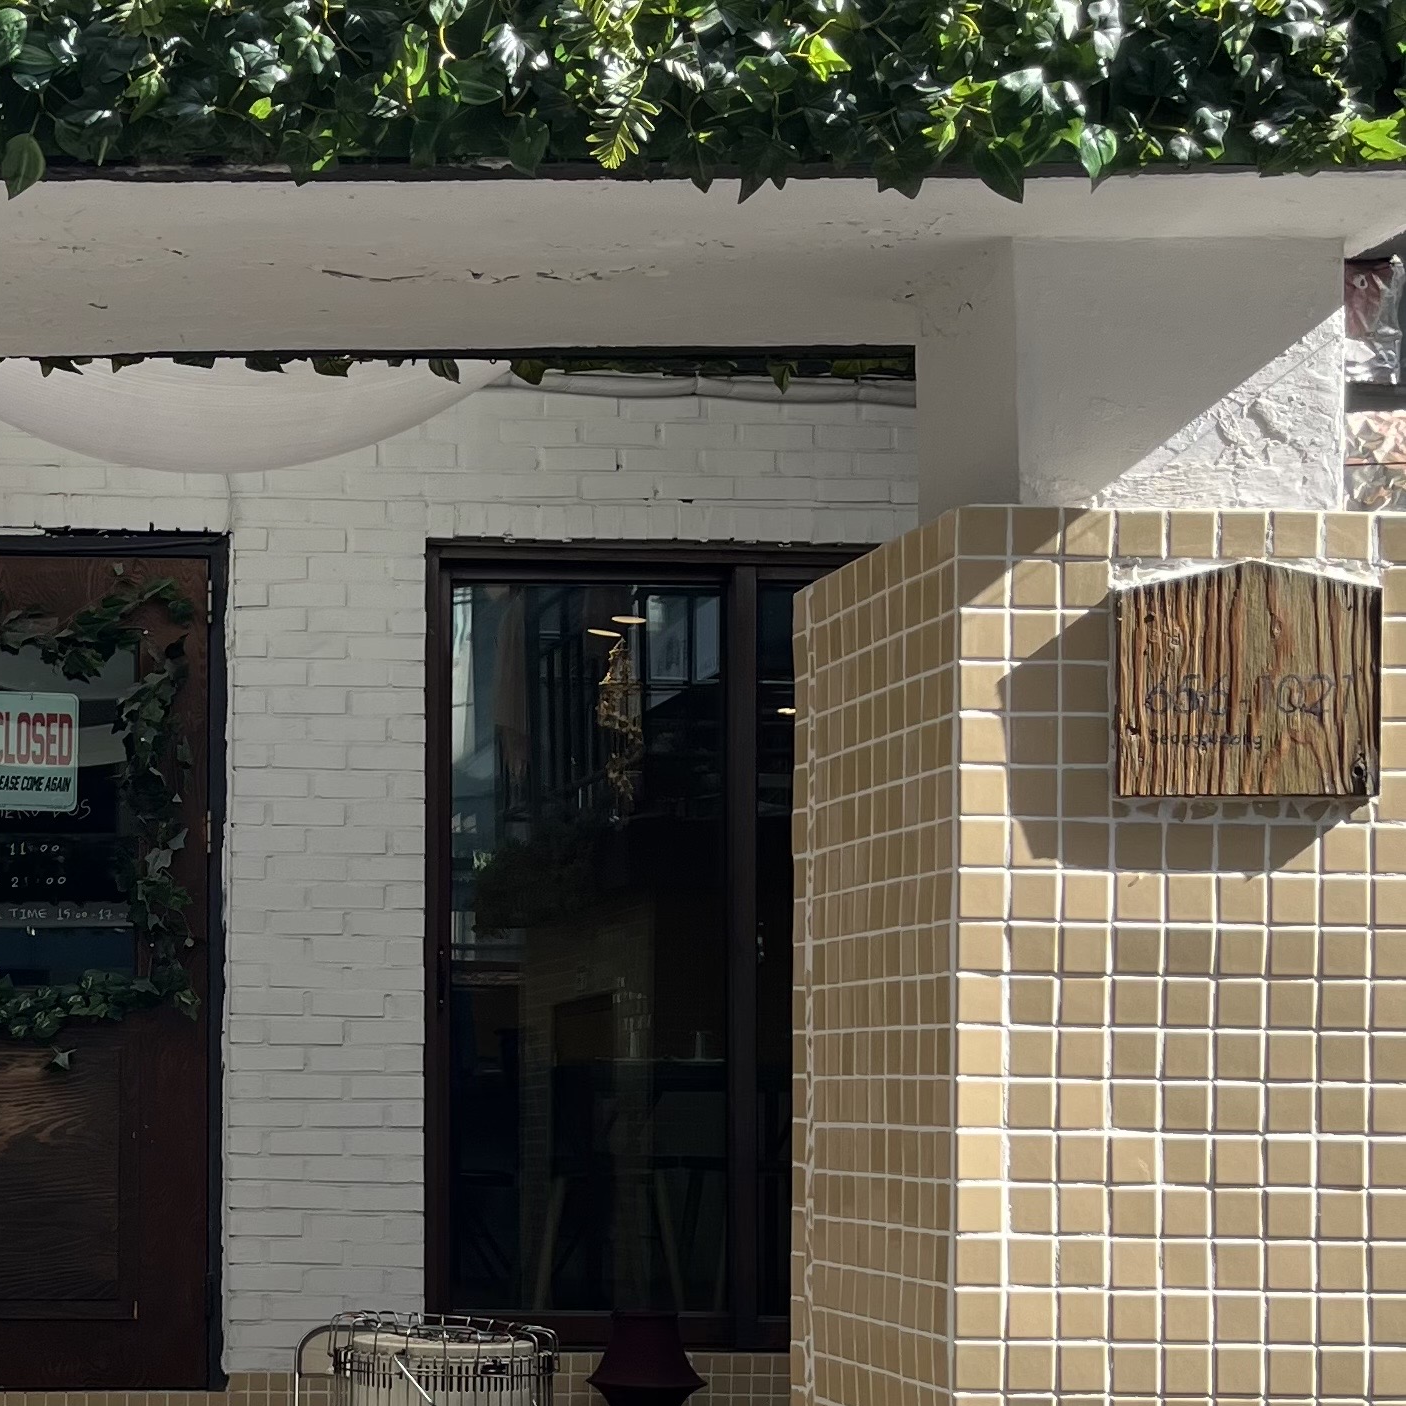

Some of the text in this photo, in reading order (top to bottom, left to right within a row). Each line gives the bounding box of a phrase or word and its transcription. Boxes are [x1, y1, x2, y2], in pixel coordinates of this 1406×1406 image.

[21, 775, 43, 791] COME
[44, 776, 71, 793] AGAIN
[8, 907, 47, 921] TIME
